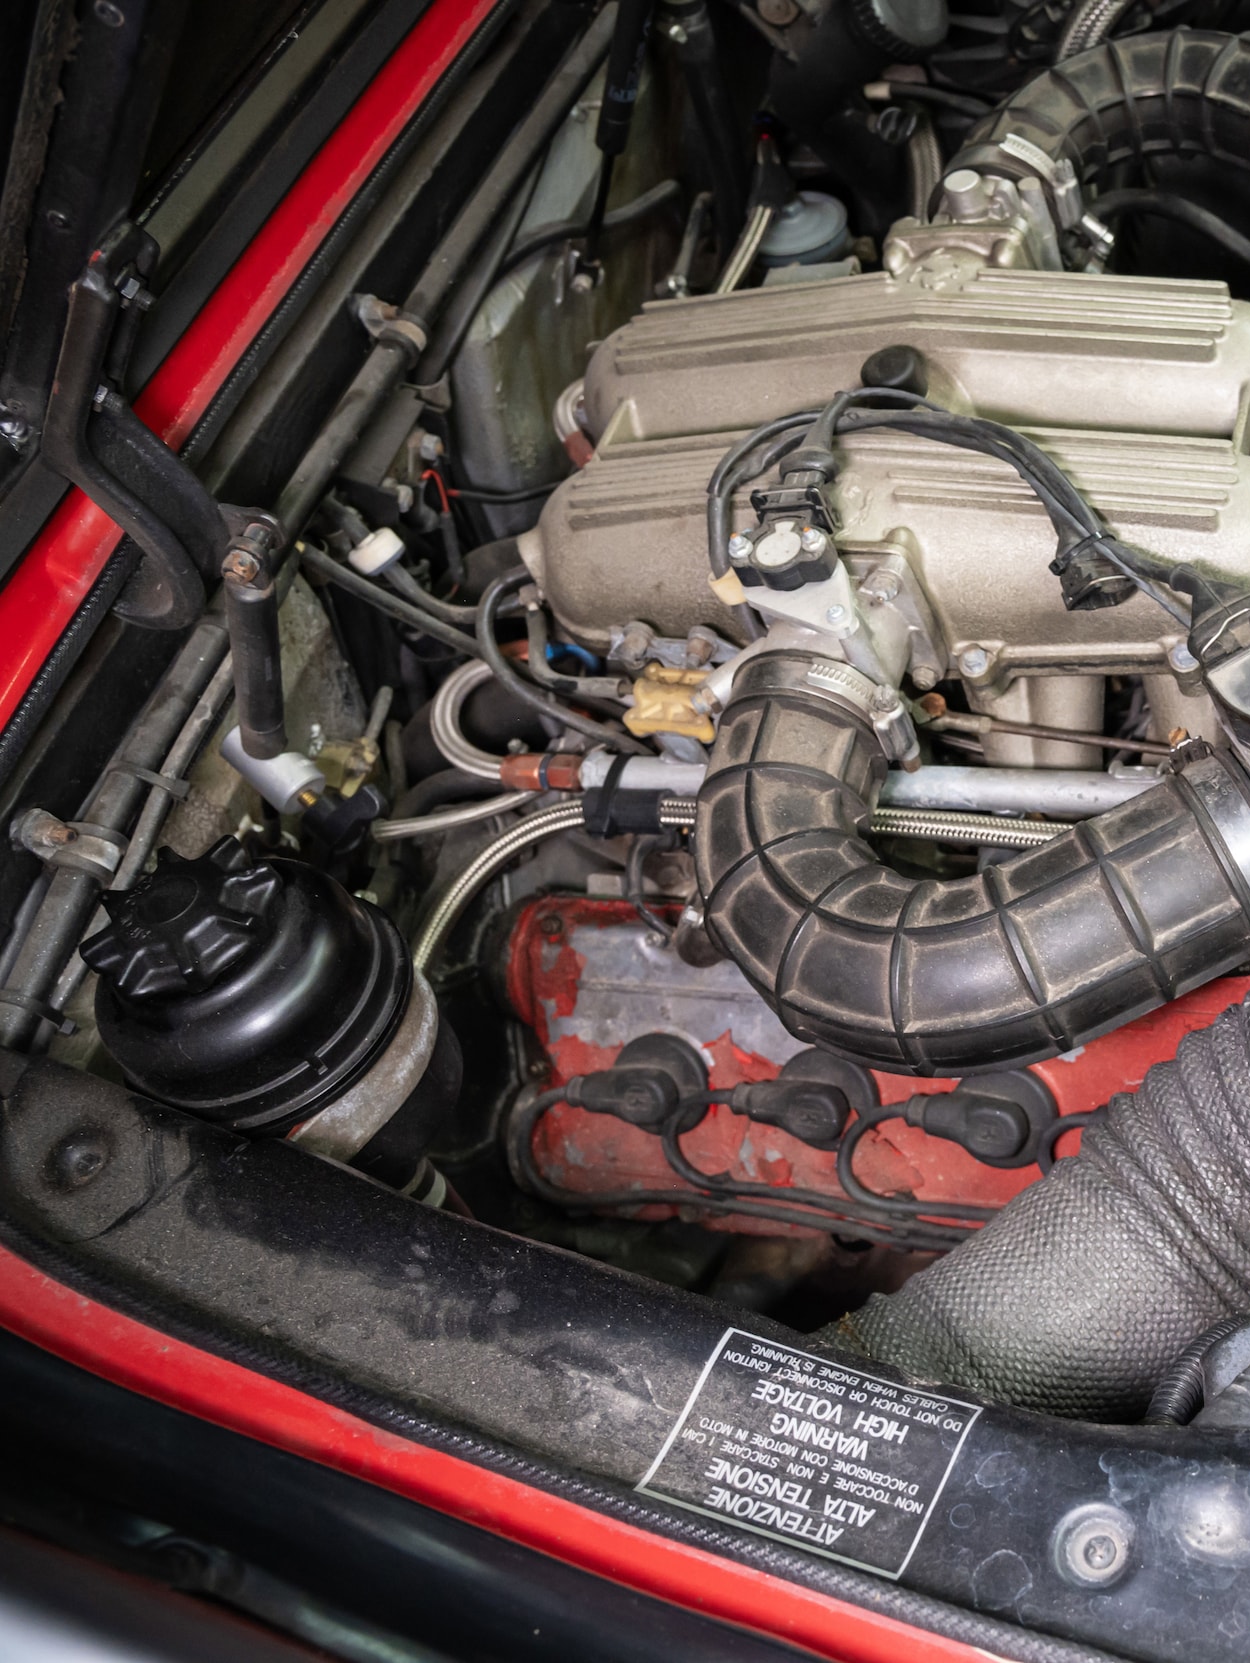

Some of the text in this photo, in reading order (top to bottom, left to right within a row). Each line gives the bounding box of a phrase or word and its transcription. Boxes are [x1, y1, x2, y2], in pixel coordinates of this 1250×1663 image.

[803, 1361, 816, 1372] IS
[817, 1366, 860, 1386] ENGINE
[723, 1350, 963, 1432] DO NOT TOUCH OR DISCONNECT IGNITION
[862, 1381, 897, 1398] WHEN
[751, 1379, 909, 1444] HIGH VOLTAGE
[902, 1388, 948, 1416] CABLES
[681, 1428, 706, 1444] CAVI
[735, 1428, 749, 1441] IN
[749, 1433, 799, 1457] MOTORE
[770, 1413, 868, 1461] WARNING
[719, 1440, 780, 1468] STACCARE
[800, 1450, 828, 1467] CON
[786, 1462, 815, 1479] NON
[818, 1472, 830, 1484] E
[831, 1459, 919, 1496] D'ACCENSIONE
[704, 1457, 876, 1527] ALTA TENSIONE
[833, 1477, 890, 1504] TOCCARE
[704, 1486, 844, 1545] ATTENZIONE
[894, 1496, 924, 1514] NON
